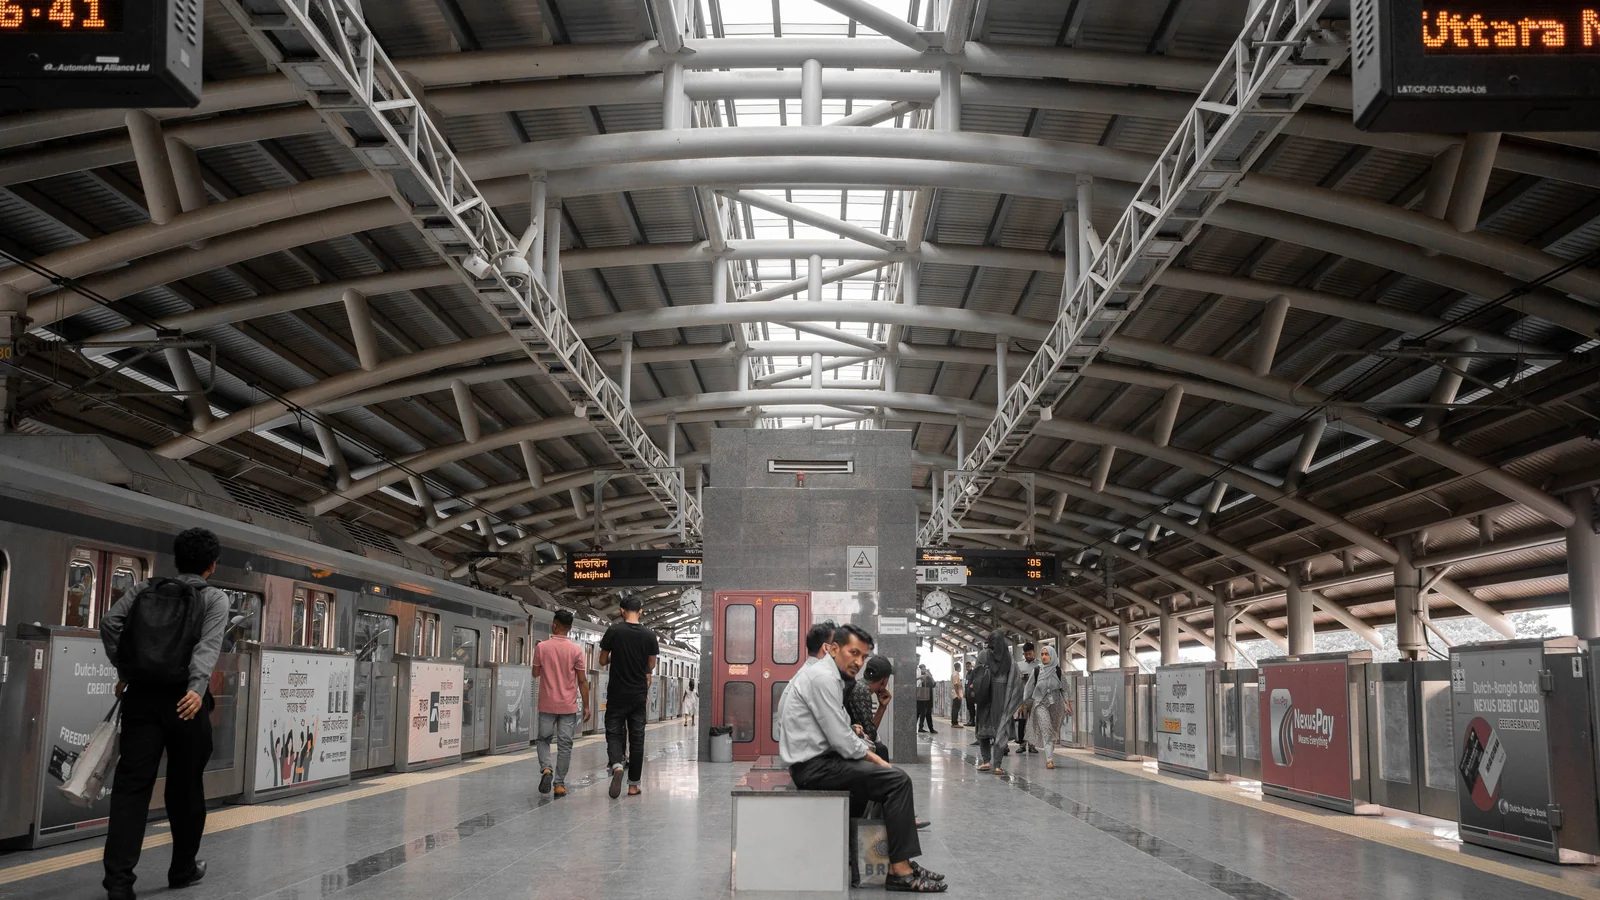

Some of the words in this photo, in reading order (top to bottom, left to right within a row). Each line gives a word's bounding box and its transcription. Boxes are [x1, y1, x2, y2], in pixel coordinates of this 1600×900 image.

[1422, 11, 1565, 47] Uttara
[57, 64, 102, 72] Autometers
[104, 64, 135, 72] Alliance
[136, 64, 150, 72] Ltd
[573, 570, 611, 580] Motijheel
[87, 683, 111, 695] CREDIT
[1473, 681, 1518, 697] Dutch-Bangla
[1519, 681, 1537, 694] Bank
[1473, 699, 1497, 712] NEXUS
[1498, 699, 1518, 712] DEBIT
[1519, 700, 1539, 713] CARD
[1294, 708, 1334, 743] NexusPay
[1499, 718, 1518, 729] SECURE
[1518, 719, 1540, 731] BANKING
